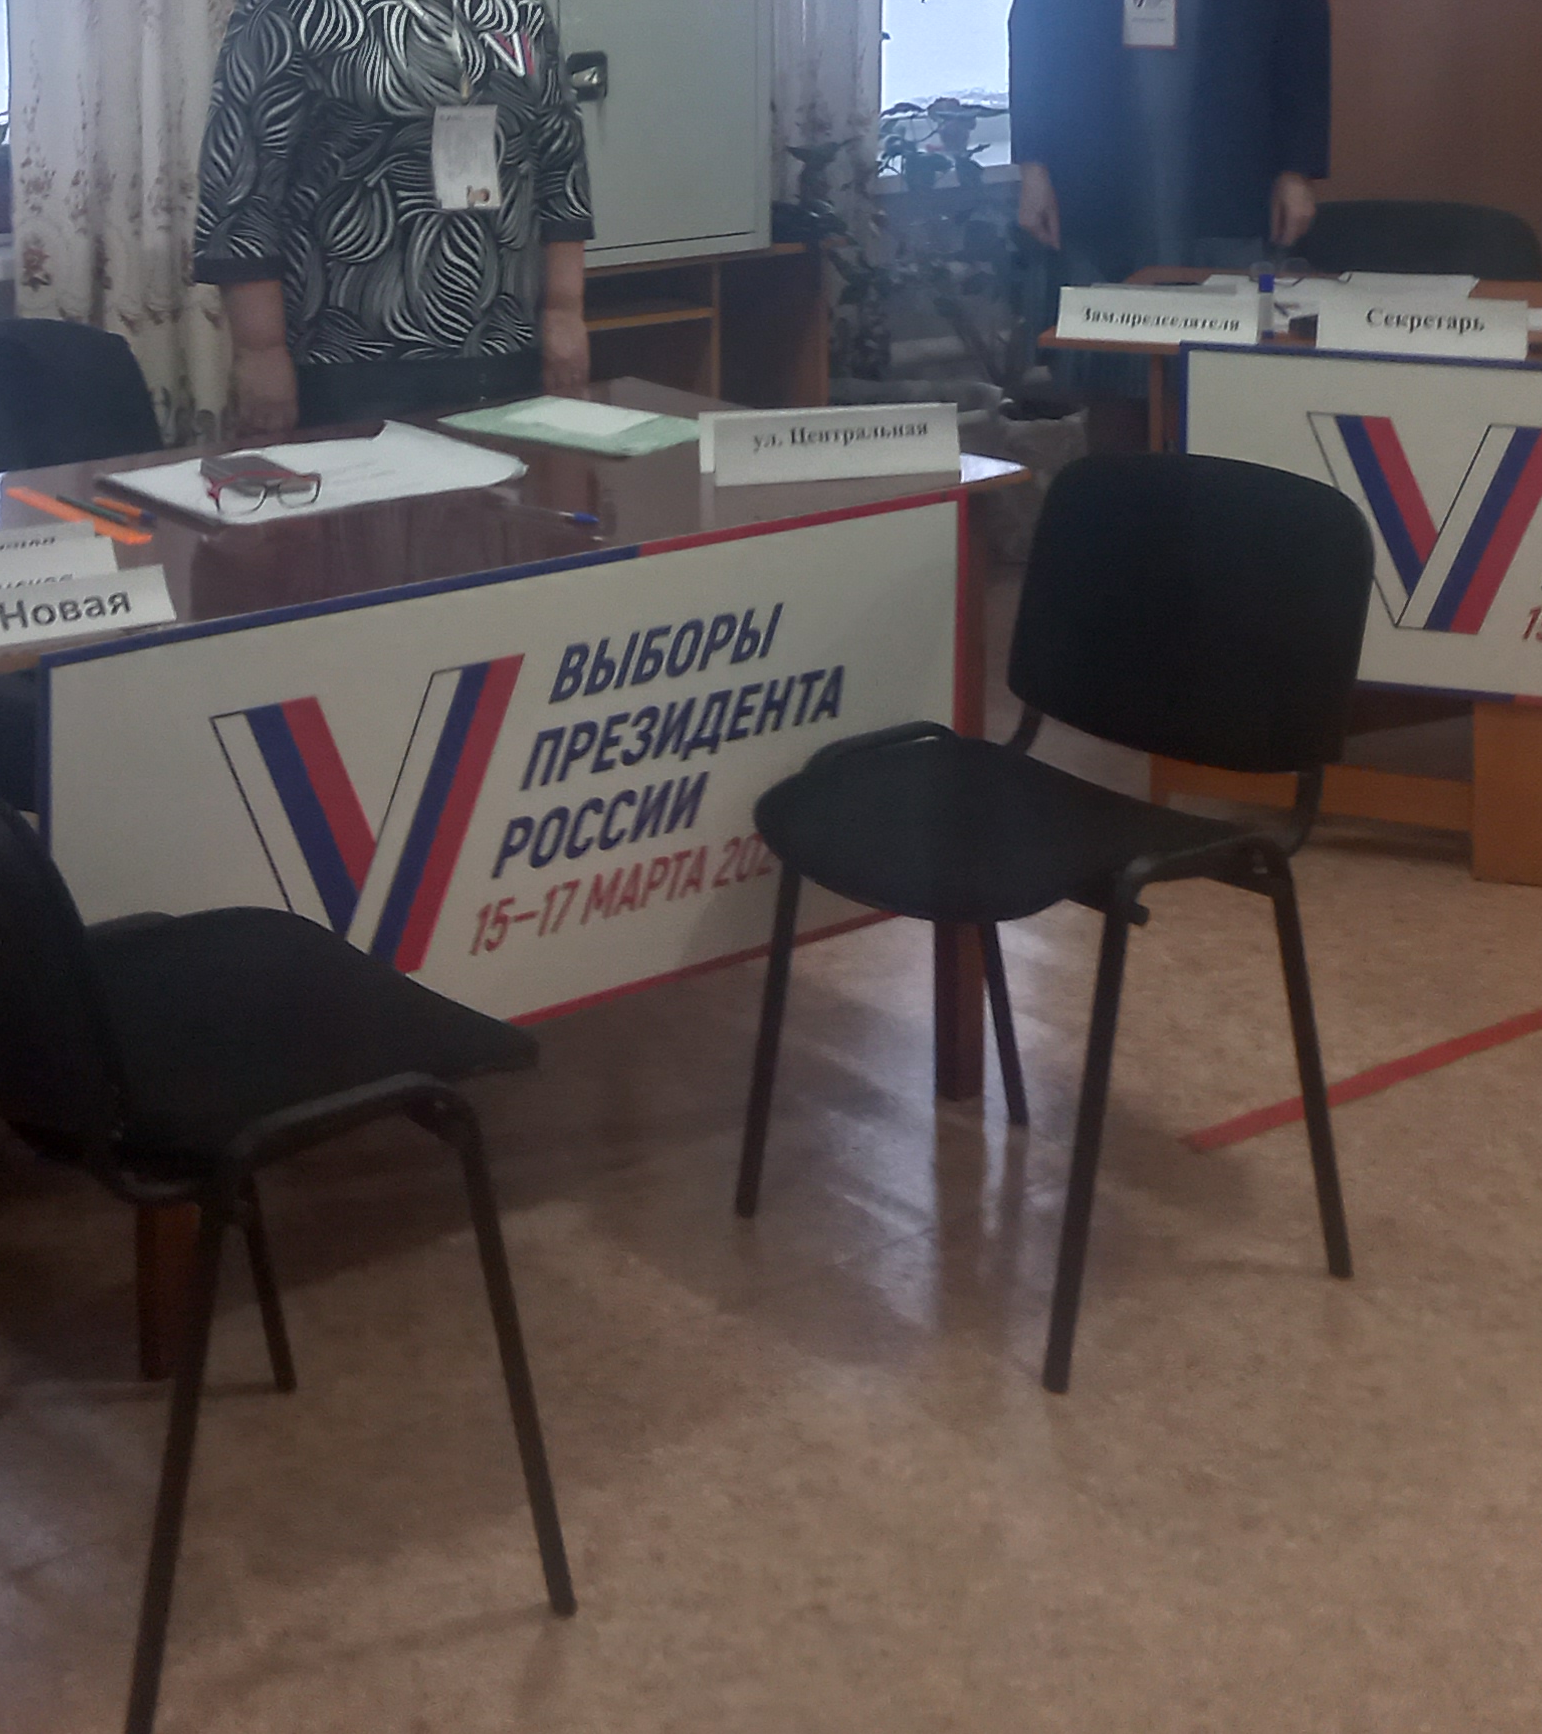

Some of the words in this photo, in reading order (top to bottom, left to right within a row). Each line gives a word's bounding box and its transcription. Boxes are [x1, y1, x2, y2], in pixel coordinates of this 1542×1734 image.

[1366, 307, 1485, 335] Секретарь
[789, 422, 929, 447] Центральная
[548, 602, 784, 705] ВЫБОРЫ
[519, 665, 844, 791] ПРЕЗИДЕНТА
[491, 771, 710, 880] РОССИИ
[469, 879, 581, 956] 15–17
[580, 845, 708, 925] МАРТА
[712, 832, 774, 888] 202
